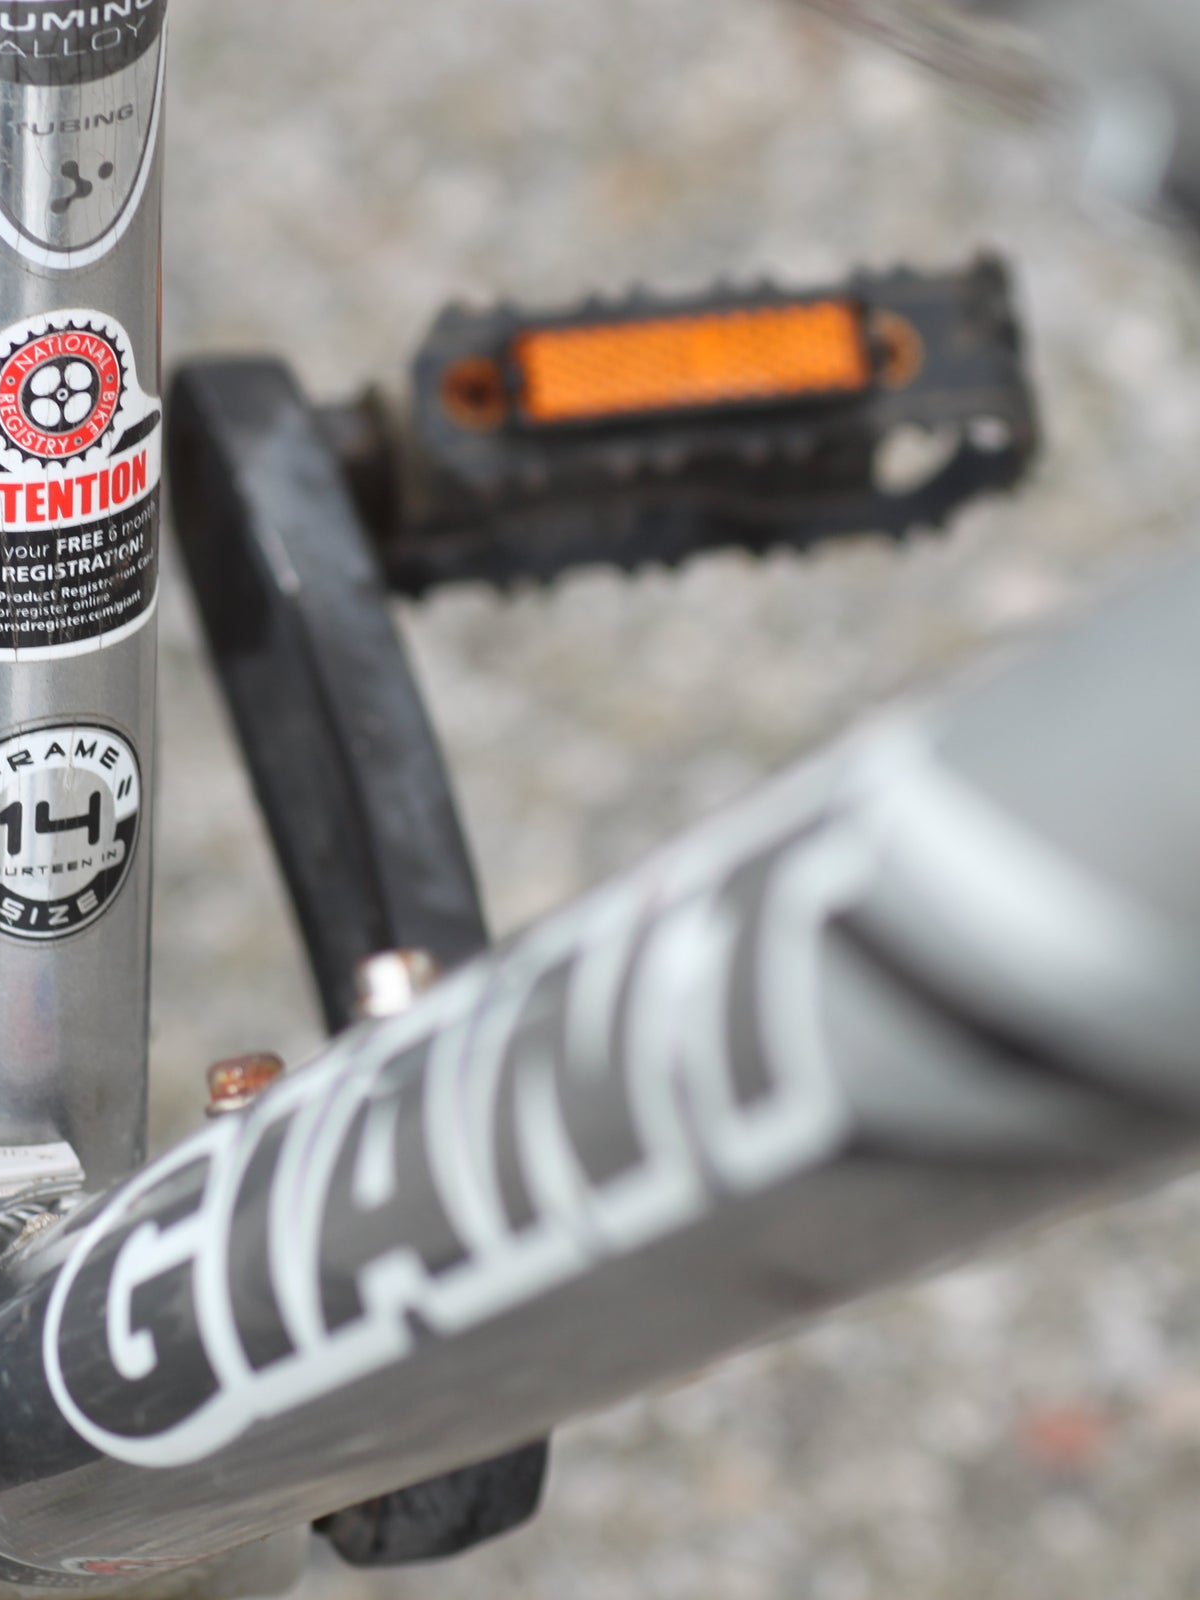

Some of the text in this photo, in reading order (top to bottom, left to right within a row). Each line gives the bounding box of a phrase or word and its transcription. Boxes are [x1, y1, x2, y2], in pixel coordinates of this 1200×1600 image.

[12, 104, 134, 136] TUBING
[15, 336, 112, 372] NATIONAL
[87, 391, 116, 437] BIKE
[2, 533, 144, 583] REGISTRATION!
[3, 543, 50, 563] your
[56, 530, 104, 555] FREE
[108, 524, 118, 542] 6
[61, 566, 136, 599] Registrtion
[15, 604, 69, 620] register
[72, 592, 110, 612] online
[102, 848, 117, 863] IN
[0, 889, 99, 926] SIZE
